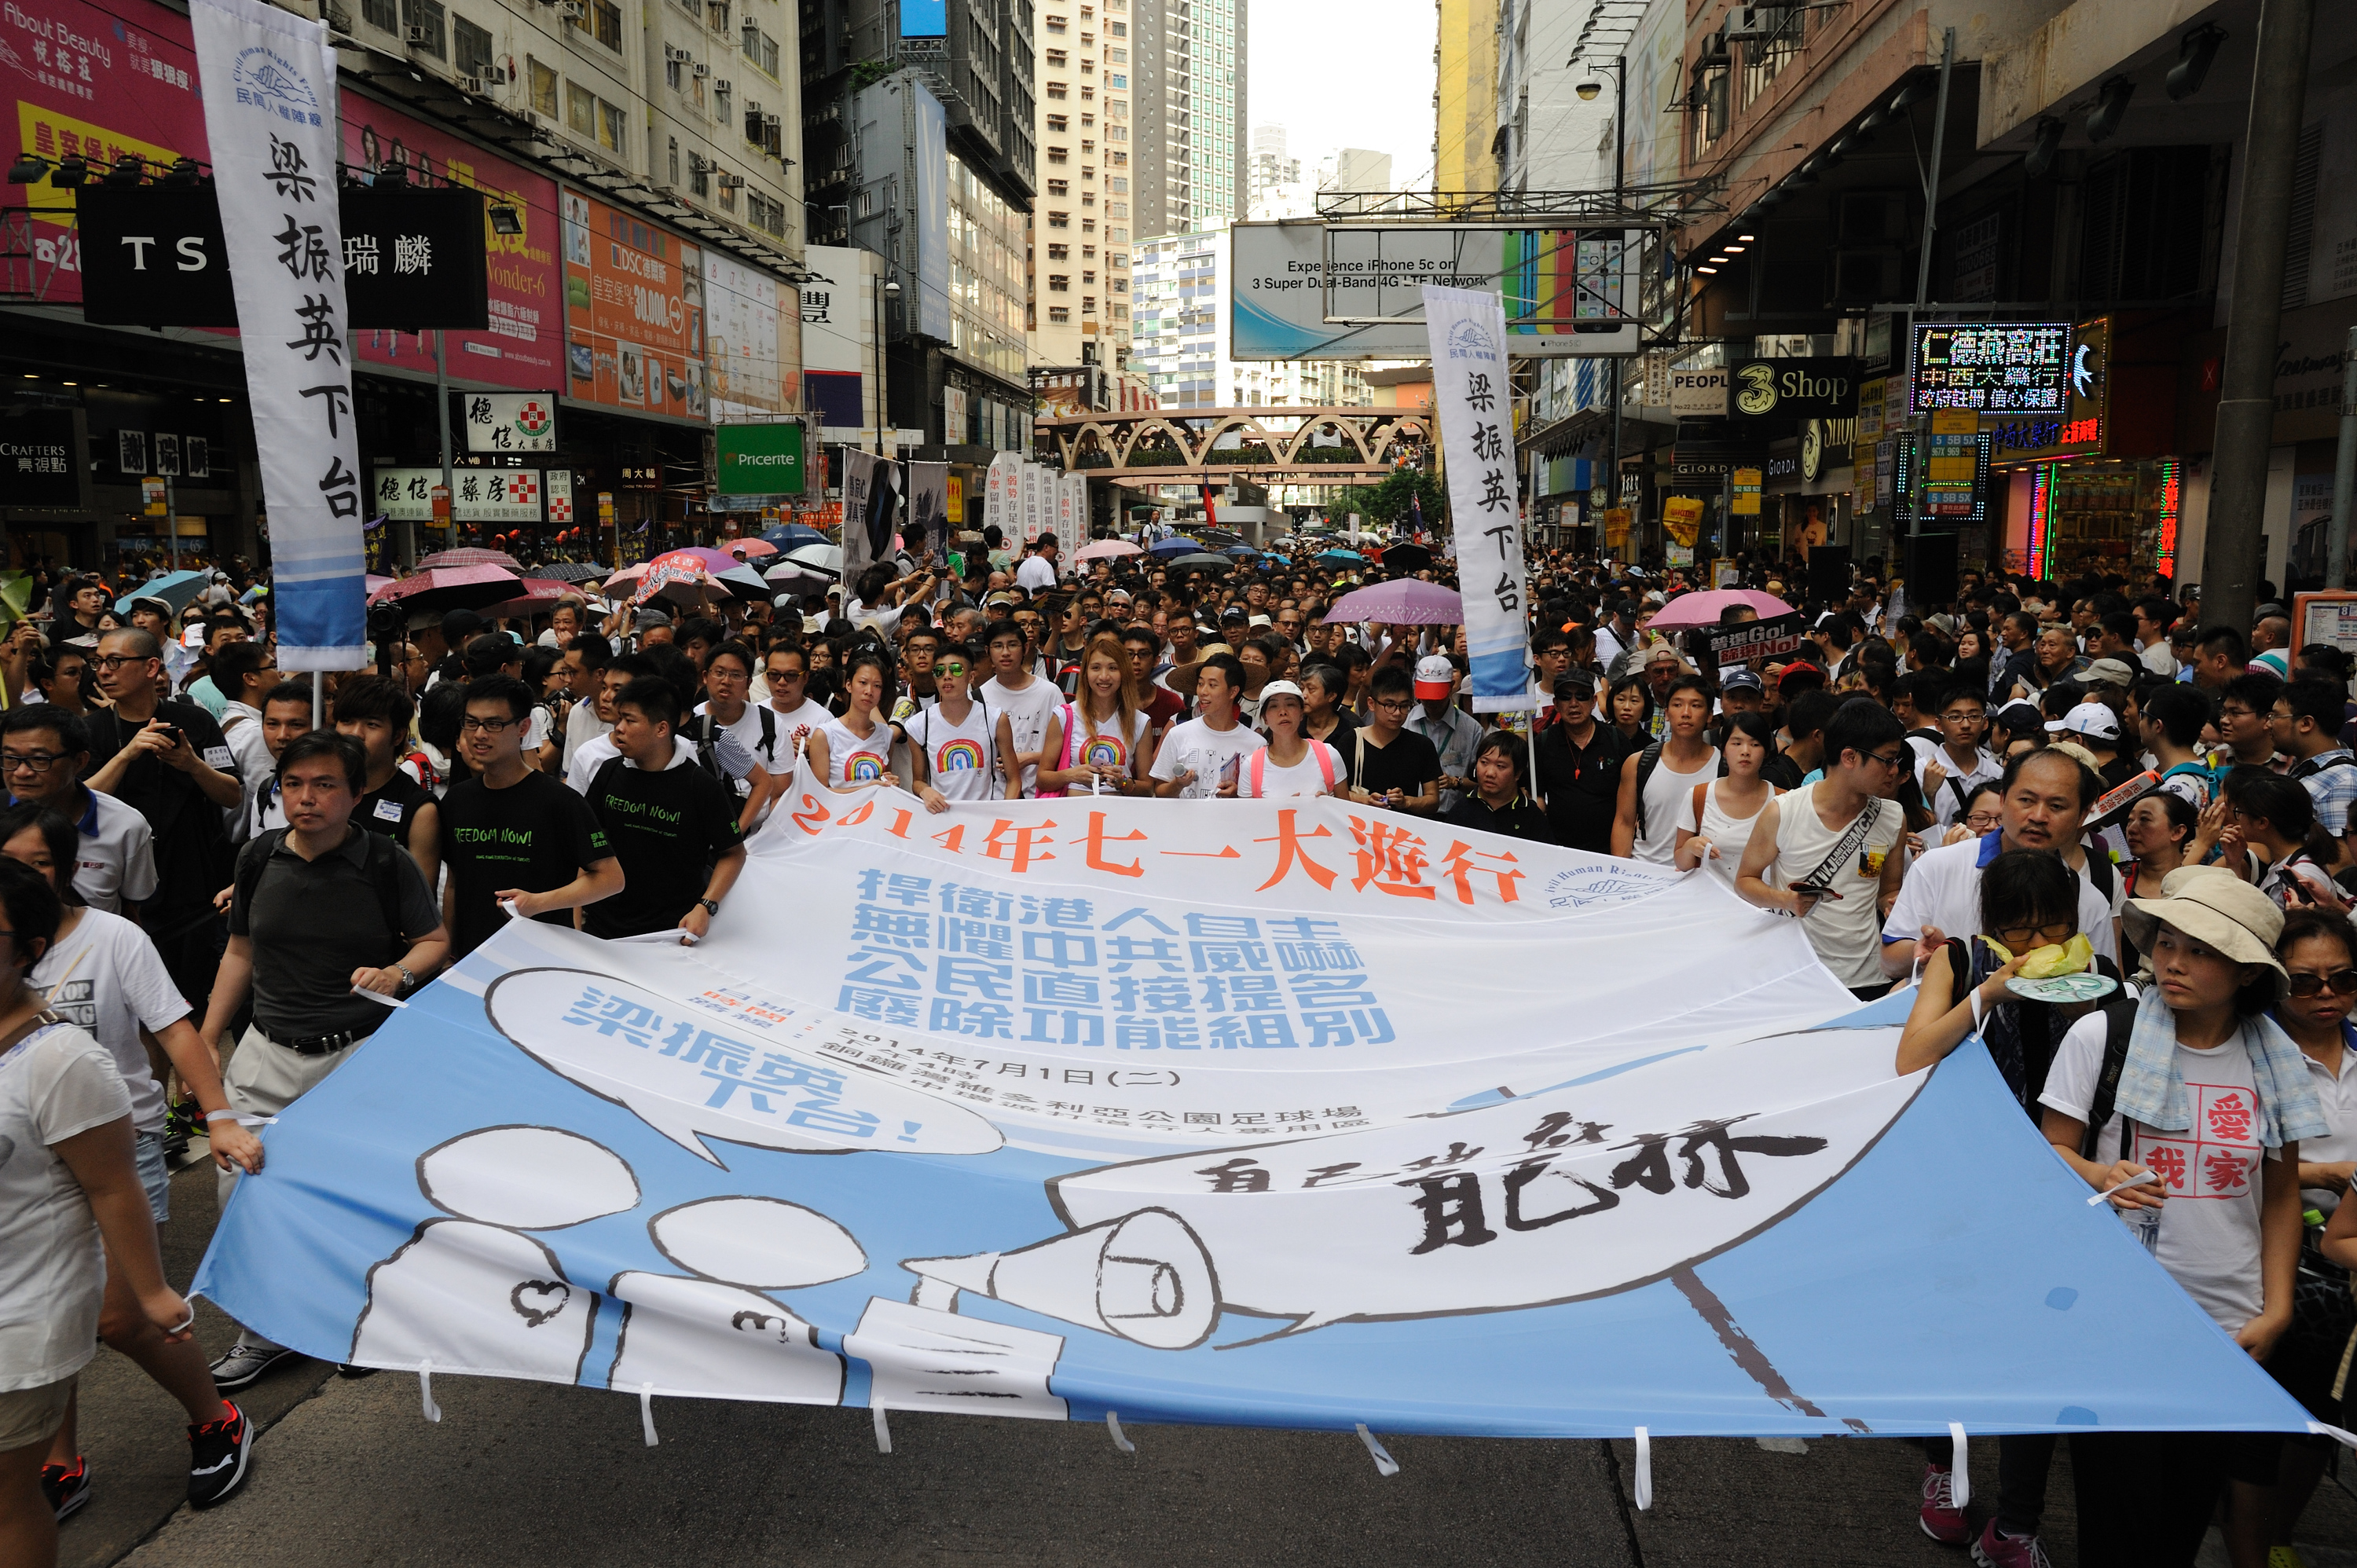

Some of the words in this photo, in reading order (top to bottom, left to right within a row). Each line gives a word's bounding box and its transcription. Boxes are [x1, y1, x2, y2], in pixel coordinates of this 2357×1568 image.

[4, 2, 53, 40] About
[57, 22, 111, 68] Beauty
[240, 47, 266, 60] Human
[267, 48, 298, 77] Rights
[236, 87, 324, 128] 民間人權陣線
[121, 236, 231, 272] TS
[344, 234, 432, 276] 瑞麟
[621, 247, 643, 276] DSC
[643, 258, 666, 285] 德爾斯
[1368, 259, 1414, 273] iPhone
[1418, 258, 1435, 272] 5c
[1439, 261, 1456, 272] on
[1252, 278, 1260, 290] 3
[1264, 277, 1304, 292] Super
[1307, 276, 1376, 289] Dual-Band
[1380, 275, 1399, 288] 4G
[1432, 275, 1489, 289] Network
[593, 274, 625, 307] 皇室堡
[634, 284, 666, 328] 30,000
[262, 131, 358, 519] 梁振英下台
[1547, 339, 1568, 347] iPhone
[1921, 328, 2063, 366] 仁德燕窩莊
[1736, 362, 1778, 415] 3
[1781, 370, 1849, 405] Shop
[1921, 367, 2060, 387] 中西大藥行
[1919, 388, 1985, 408] 政府註冊
[1990, 388, 2058, 408] 信心保證
[0, 443, 66, 456] CRAFTERS
[1931, 447, 1945, 456] 967X
[1947, 447, 1960, 456] 969
[1936, 435, 1942, 445] 5
[1947, 435, 1961, 445] 5B
[1963, 435, 1977, 445] 5X
[17, 457, 67, 473] 亮視點
[621, 467, 657, 480] 周大福
[738, 452, 795, 467] Pricerite
[379, 474, 506, 503] 德信藥房
[550, 471, 568, 481] 政府
[550, 484, 568, 495] 認可
[1464, 372, 1522, 611] 梁振英下台
[1931, 493, 1938, 502] 5
[1942, 493, 1956, 502] 5B
[1958, 493, 1971, 502] 5X
[135, 538, 147, 553] 65
[189, 538, 201, 553] 65
[2341, 606, 2348, 616] 8
[604, 794, 646, 817] FREEDOM
[650, 805, 681, 825] NOW!
[453, 827, 497, 844] FREEDOM
[501, 827, 532, 847] NOW!
[791, 793, 1527, 906] 2014年七一大遊行
[1830, 836, 1853, 861] LIMITED
[1835, 840, 1858, 866] EDITION
[1557, 865, 1604, 881] Human
[851, 903, 1365, 973] 無懼中共威嚇
[844, 945, 1378, 1013] 公民直接提名
[834, 984, 1397, 1051] 廢除功能組別
[562, 986, 849, 1103] 梁振英
[840, 1027, 1181, 1088] 2014年7月1日(二)
[821, 1041, 1363, 1126] 銅鑼灣維多利亞公園足球場
[698, 1069, 923, 1144] 下台!
[2207, 1093, 2253, 1141] 愛
